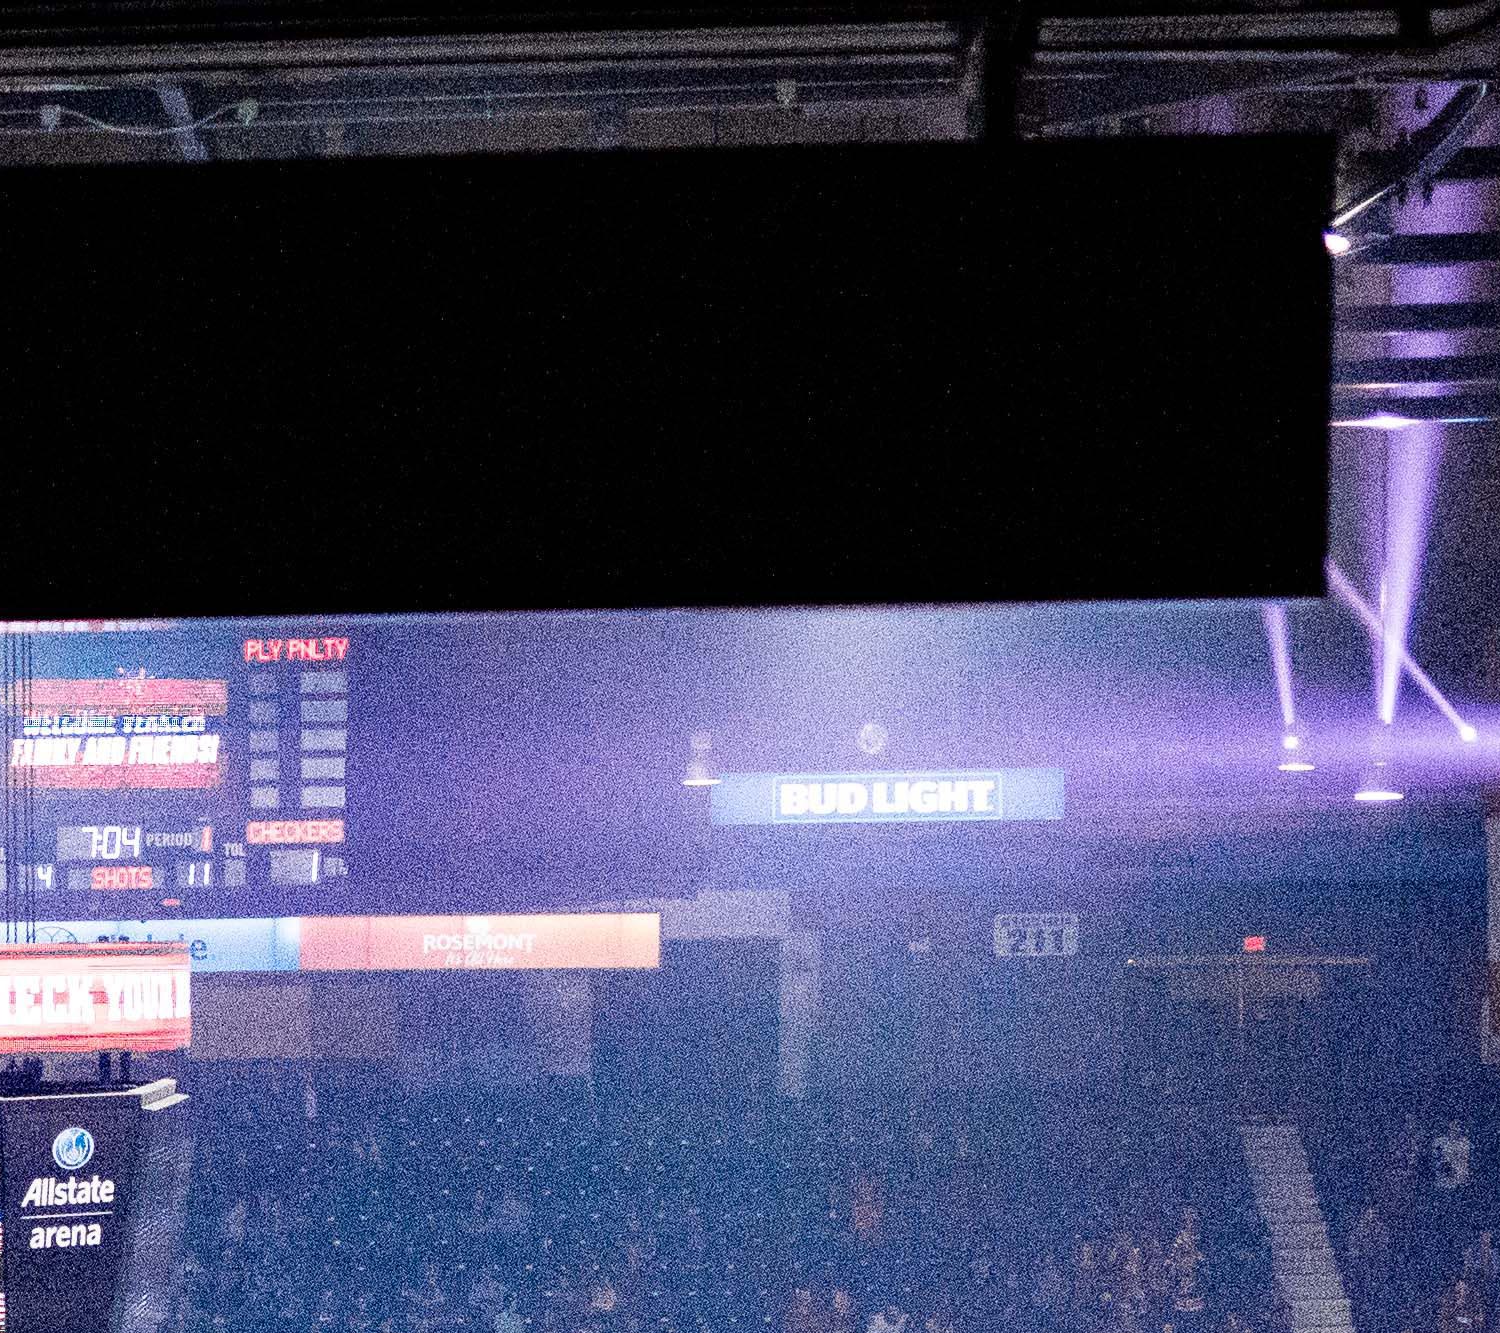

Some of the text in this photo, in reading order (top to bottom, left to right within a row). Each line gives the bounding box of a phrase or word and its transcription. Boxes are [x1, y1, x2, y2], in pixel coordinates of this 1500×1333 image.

[243, 637, 349, 662] PLY PNLTY
[780, 780, 994, 814] BUD LIGHT
[81, 826, 142, 858] 7:04
[246, 820, 346, 844] CHECKERS
[36, 863, 55, 889] 4
[90, 867, 153, 889] SHOTS
[422, 933, 536, 954] ROSEMONT
[20, 1175, 116, 1209] Allstate
[29, 1222, 102, 1250] arena
